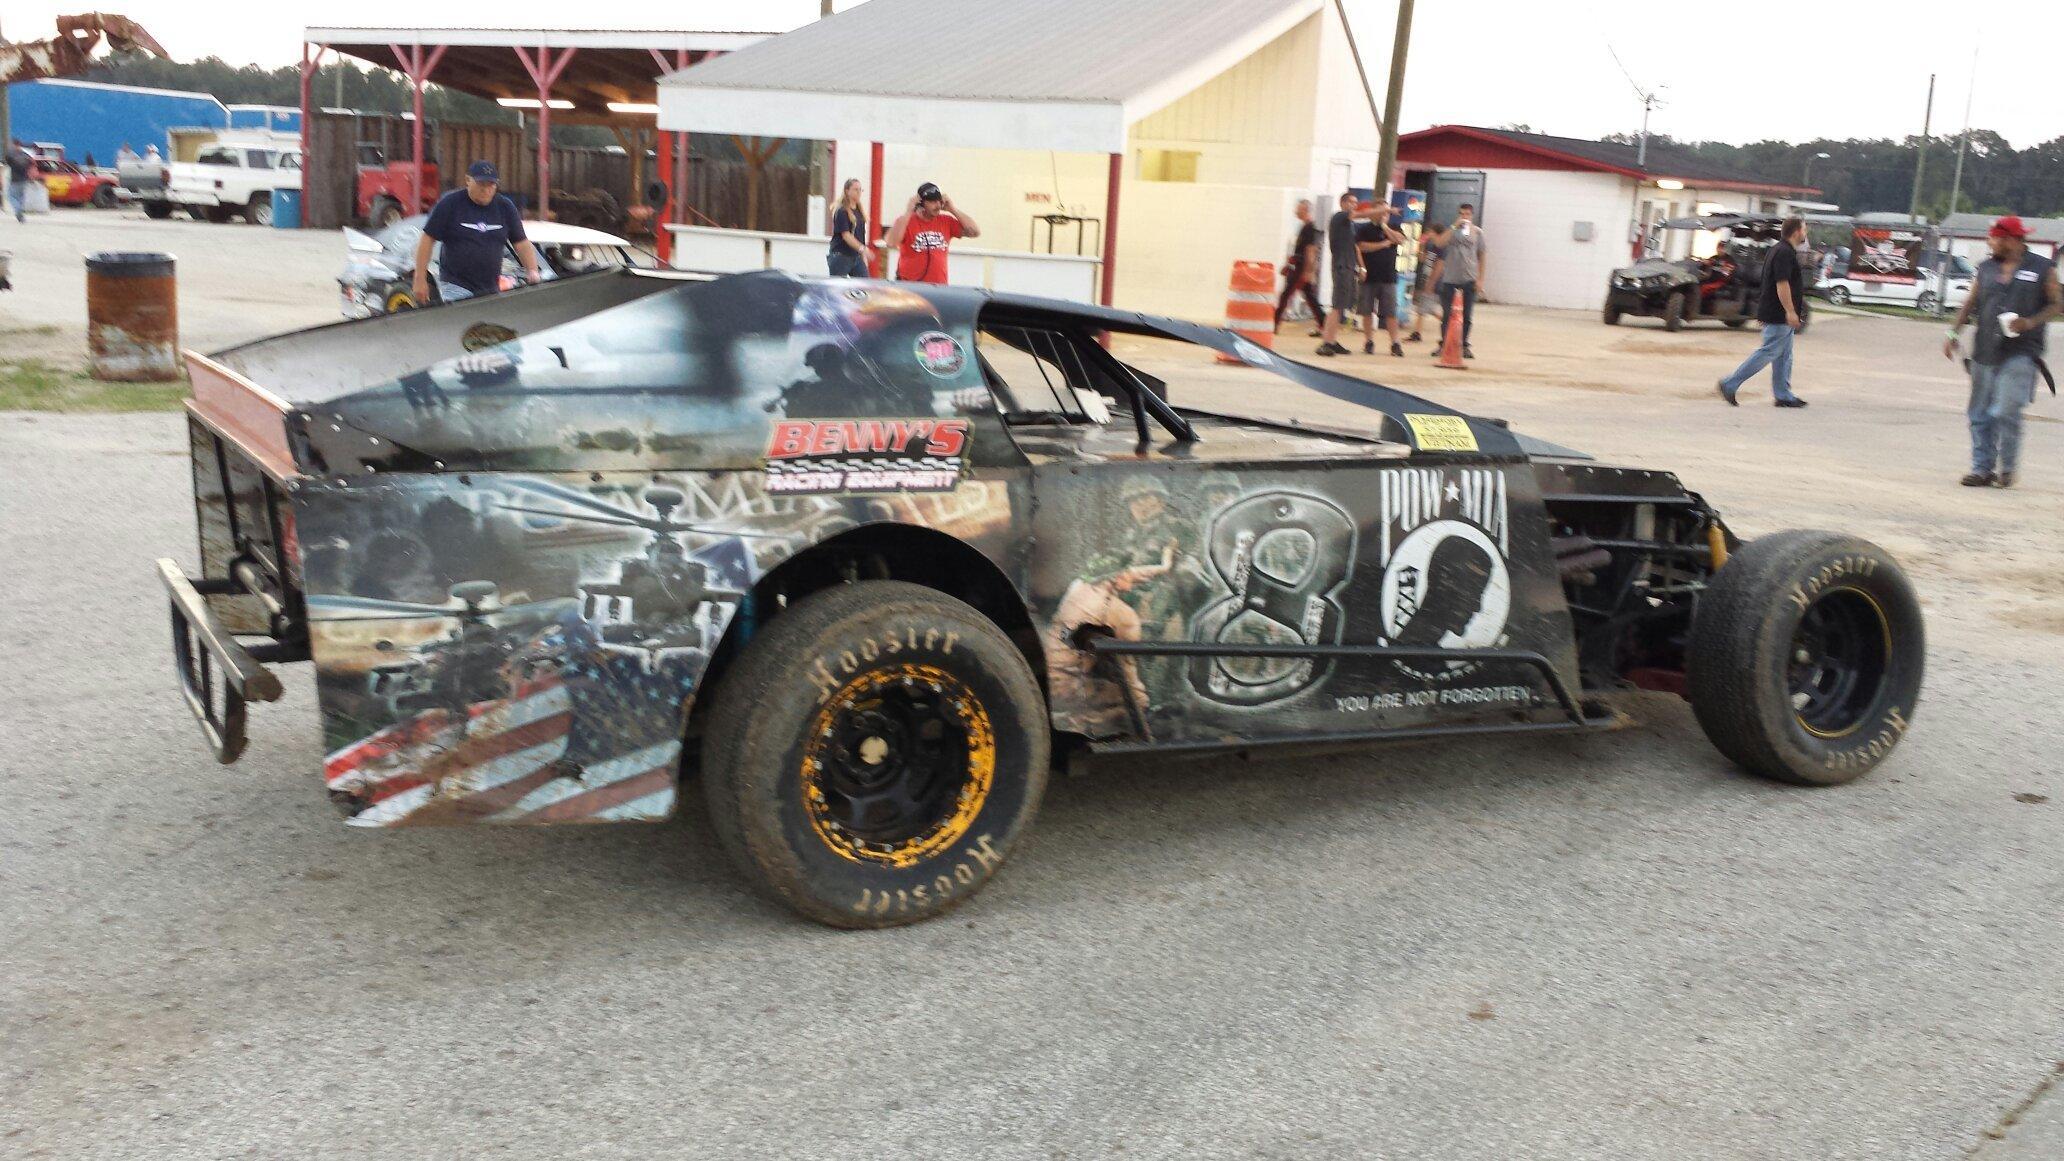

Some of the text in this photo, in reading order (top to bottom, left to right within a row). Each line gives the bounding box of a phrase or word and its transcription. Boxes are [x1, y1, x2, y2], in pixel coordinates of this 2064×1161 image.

[764, 419, 969, 459] BENNY'S
[764, 470, 959, 490] RACING EQUIPMENT
[1379, 469, 1444, 569] POW
[1187, 488, 1358, 709] 8
[1335, 696, 1369, 713] YOU
[1372, 692, 1402, 709] ARE
[1406, 690, 1438, 706] NOT
